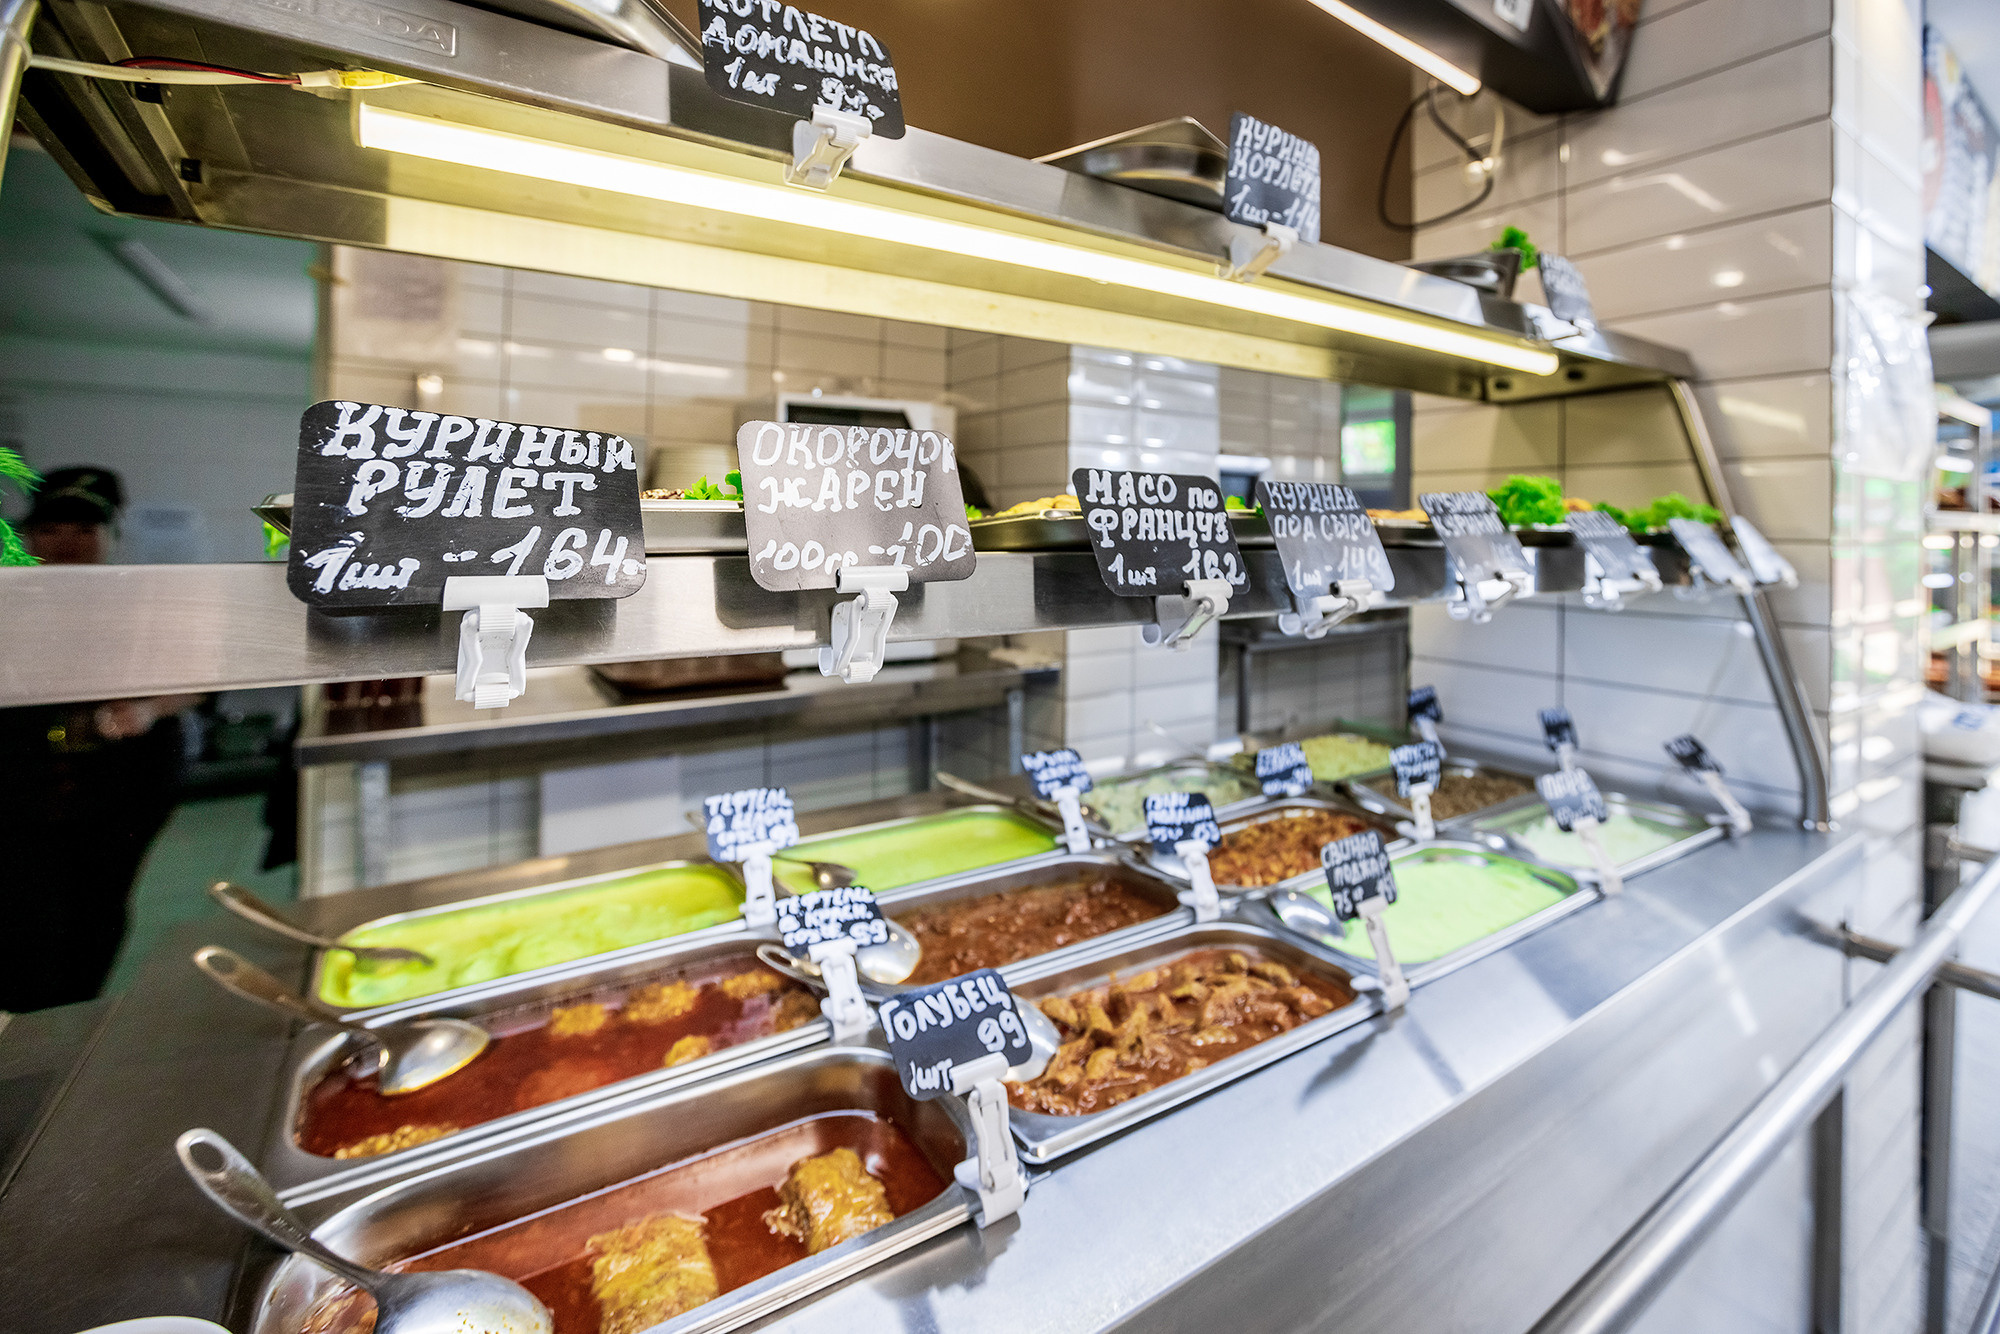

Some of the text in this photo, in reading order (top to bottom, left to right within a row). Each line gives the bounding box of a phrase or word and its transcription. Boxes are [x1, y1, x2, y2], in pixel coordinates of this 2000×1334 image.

[346, 460, 598, 519] РУЛЕТ
[758, 467, 927, 514] ЖАРЕН
[1086, 469, 1219, 510] МЯСО по
[1088, 507, 1230, 549] ФРАНЦУЗ
[1274, 514, 1316, 542] ПОД
[1182, 549, 1246, 586] 162
[878, 975, 1012, 1044] ГОЛУБЕЦ
[977, 1010, 1027, 1052] 99
